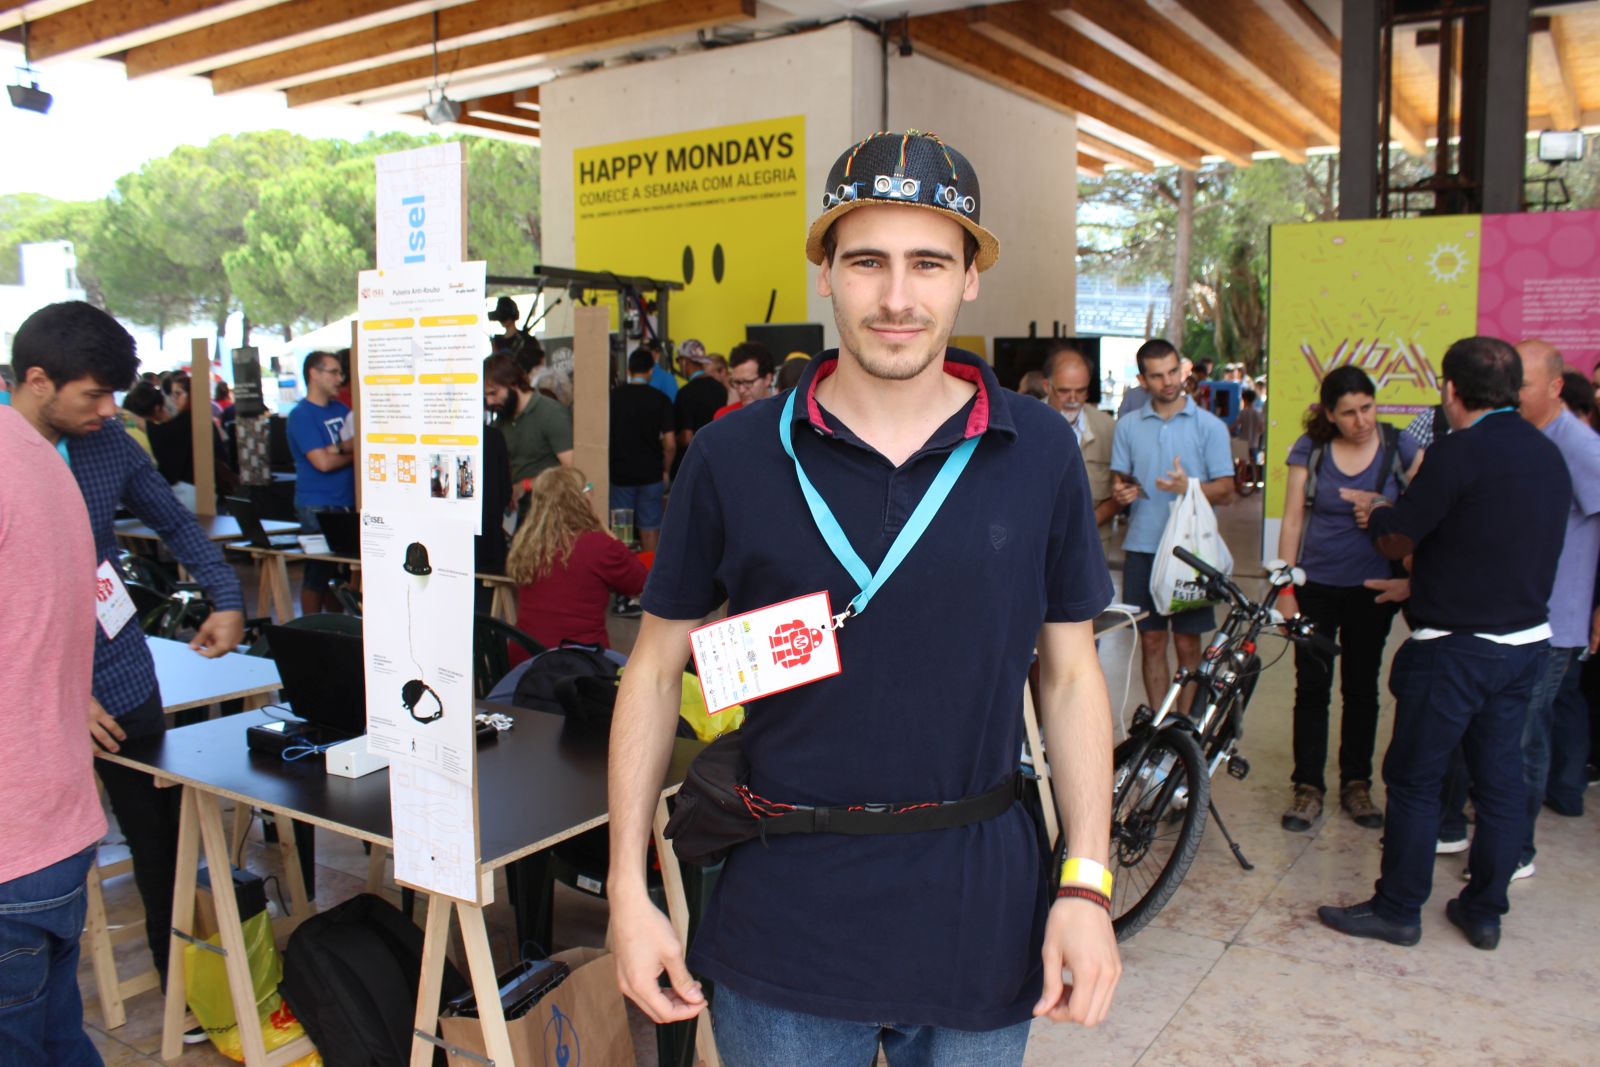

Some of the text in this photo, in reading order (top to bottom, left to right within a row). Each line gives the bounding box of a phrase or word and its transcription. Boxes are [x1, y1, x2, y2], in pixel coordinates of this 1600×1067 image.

[580, 132, 794, 185] HAPPY MONDAYS
[579, 187, 630, 207] COMECE
[632, 186, 642, 200] A
[644, 179, 699, 199] SEMANA
[702, 175, 733, 192] COM
[736, 167, 797, 187] ALEGRIA
[370, 516, 385, 525] ISEL
